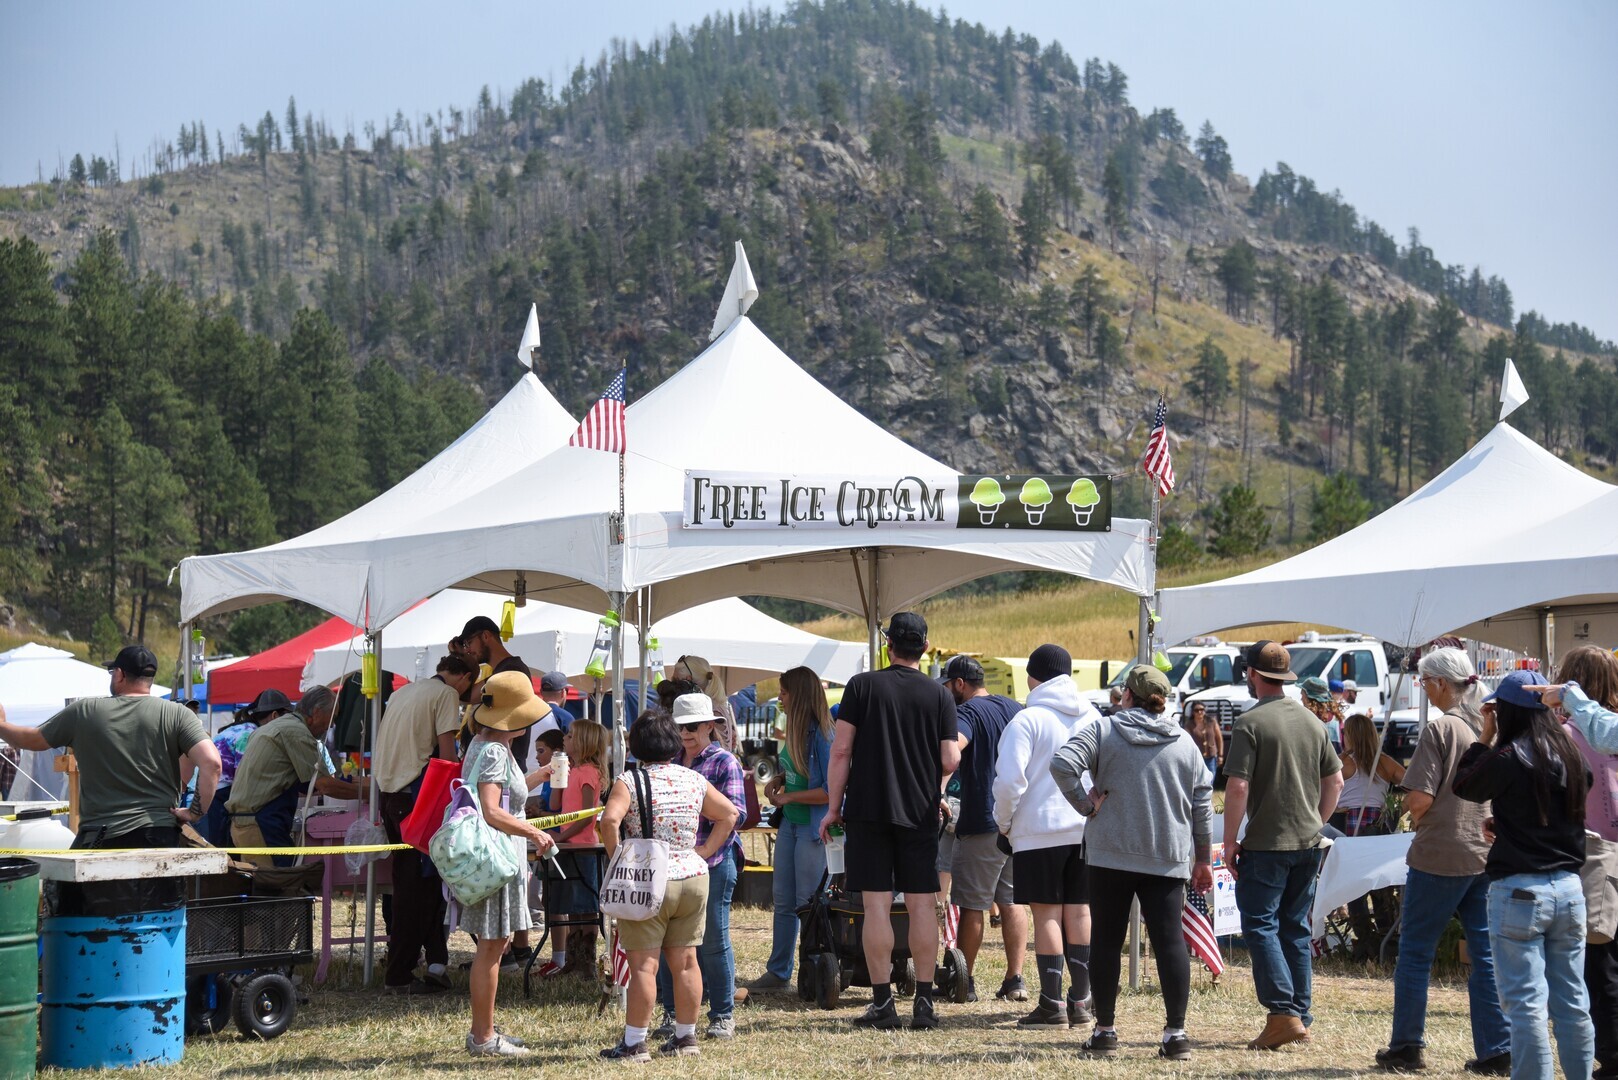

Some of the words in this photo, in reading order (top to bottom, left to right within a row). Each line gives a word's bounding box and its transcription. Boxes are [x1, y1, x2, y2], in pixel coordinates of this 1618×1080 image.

[691, 477, 767, 528] FREE
[777, 479, 826, 526] ICE
[836, 475, 946, 529] CREAM
[605, 888, 626, 904] TEA
[630, 890, 652, 907] CUP
